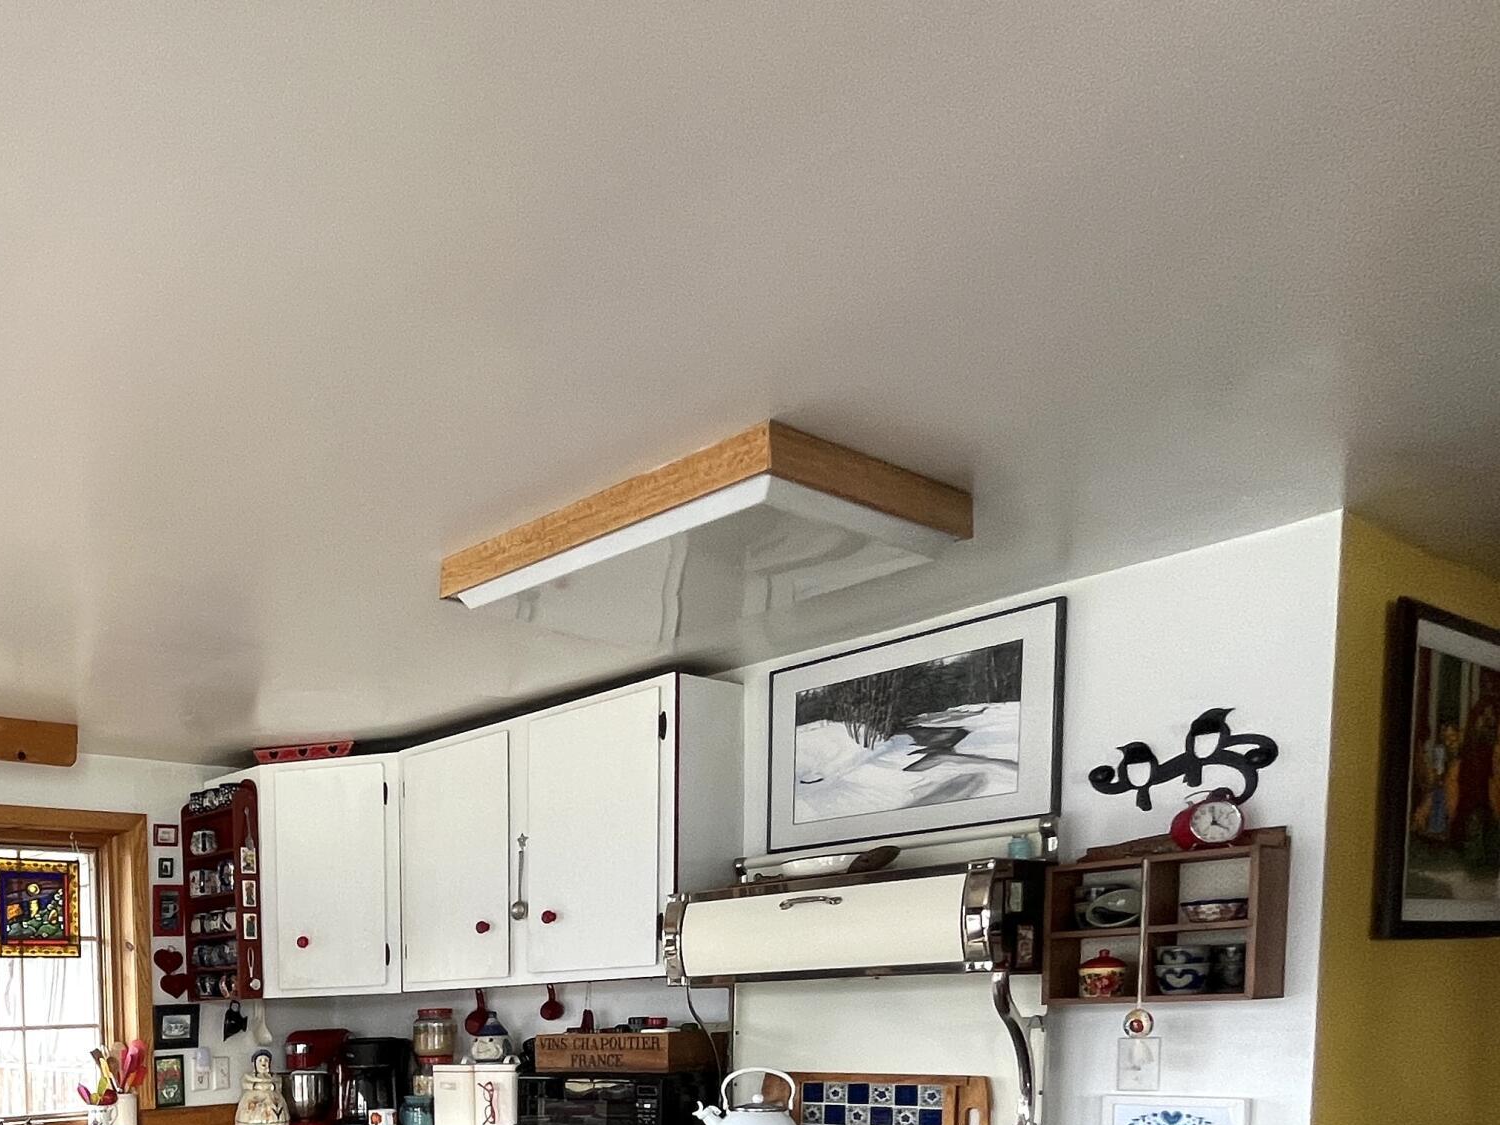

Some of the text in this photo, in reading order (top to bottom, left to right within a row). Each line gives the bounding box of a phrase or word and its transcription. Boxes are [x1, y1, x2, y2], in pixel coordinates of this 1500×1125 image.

[540, 1036, 660, 1050] VINS CHAPOUTIER
[571, 1054, 623, 1067] FRANCE
